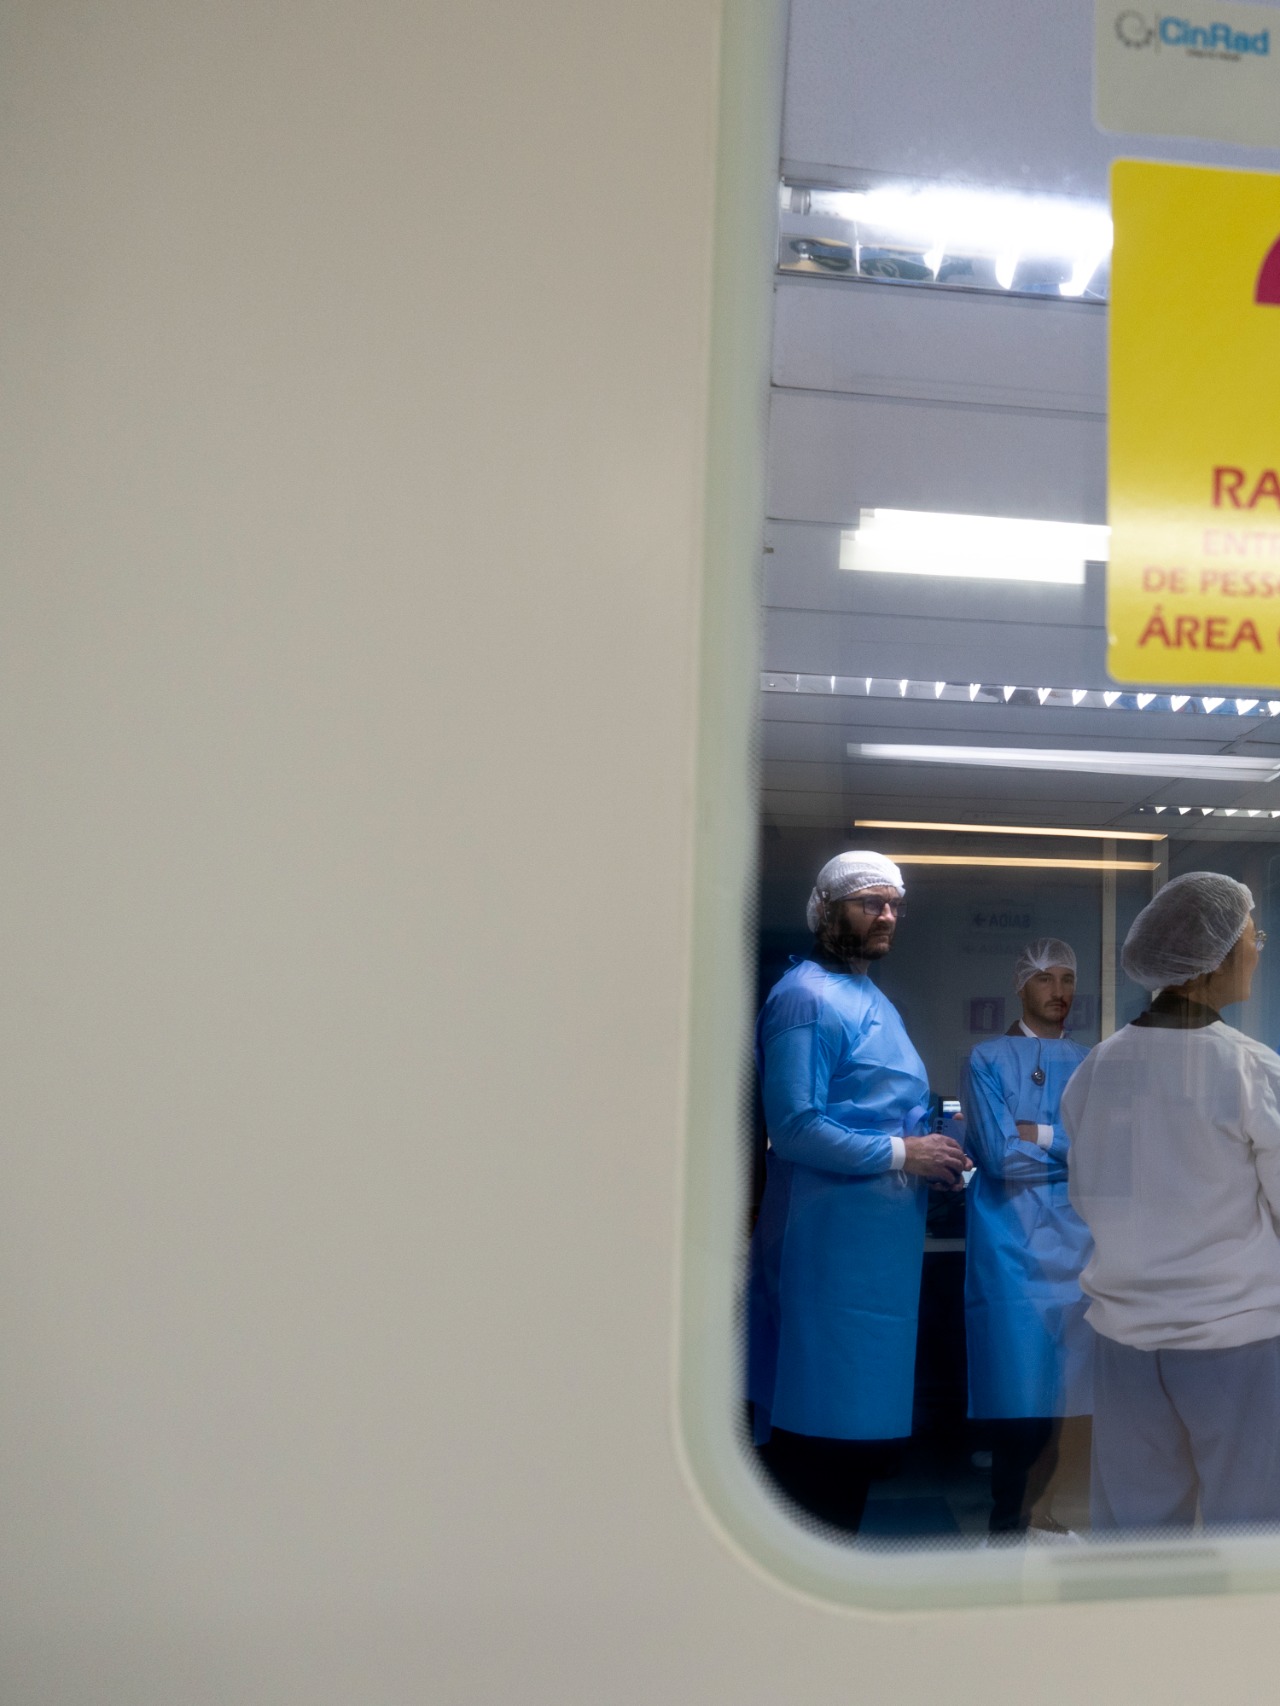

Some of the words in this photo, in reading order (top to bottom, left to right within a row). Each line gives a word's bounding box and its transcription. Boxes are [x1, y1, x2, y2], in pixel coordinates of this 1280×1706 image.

[1159, 17, 1270, 56] CinRad
[1142, 567, 1185, 593] DE
[1138, 605, 1263, 652] ÁREA
